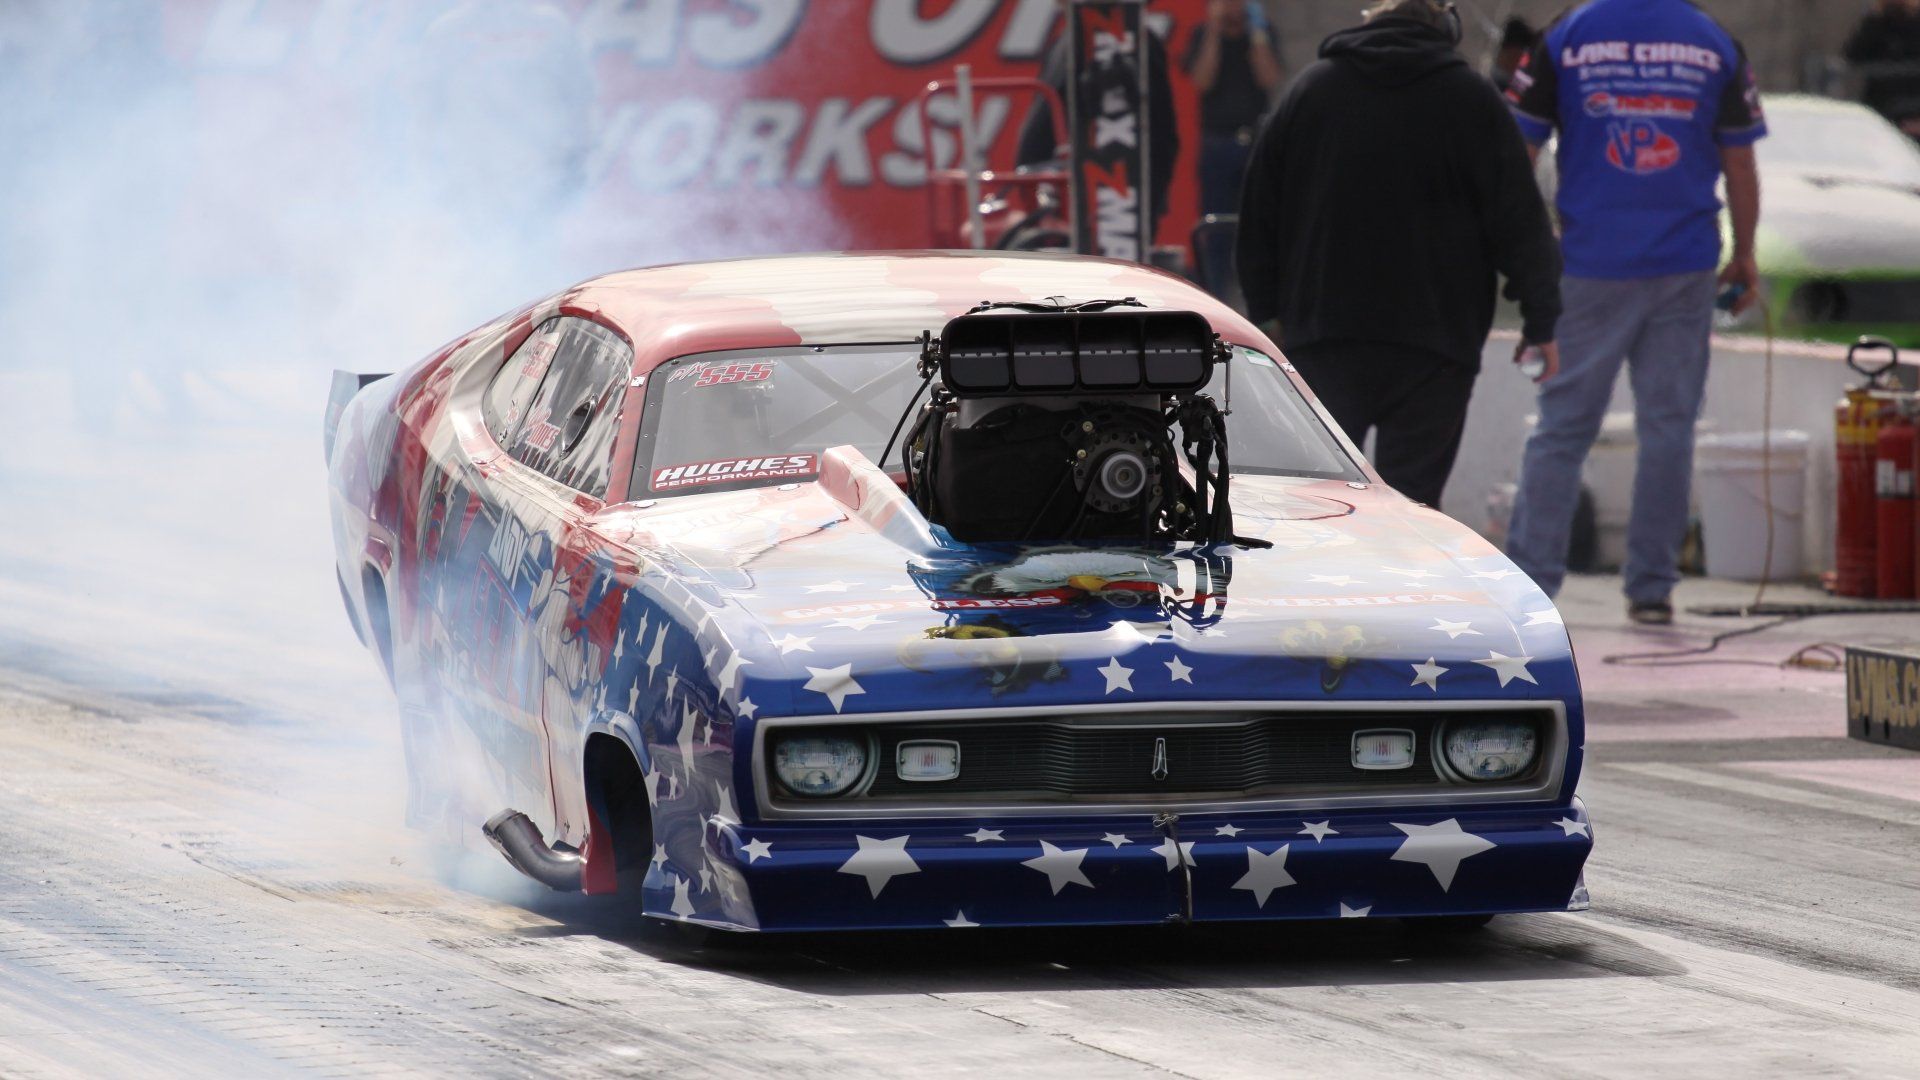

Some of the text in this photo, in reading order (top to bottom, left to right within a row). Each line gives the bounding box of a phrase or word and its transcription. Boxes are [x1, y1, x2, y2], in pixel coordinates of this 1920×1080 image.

[1561, 41, 1721, 72] LANE CHOICE
[695, 361, 778, 388] 555
[655, 455, 813, 483] HUGHES
[655, 467, 812, 489] PERFORMANCE
